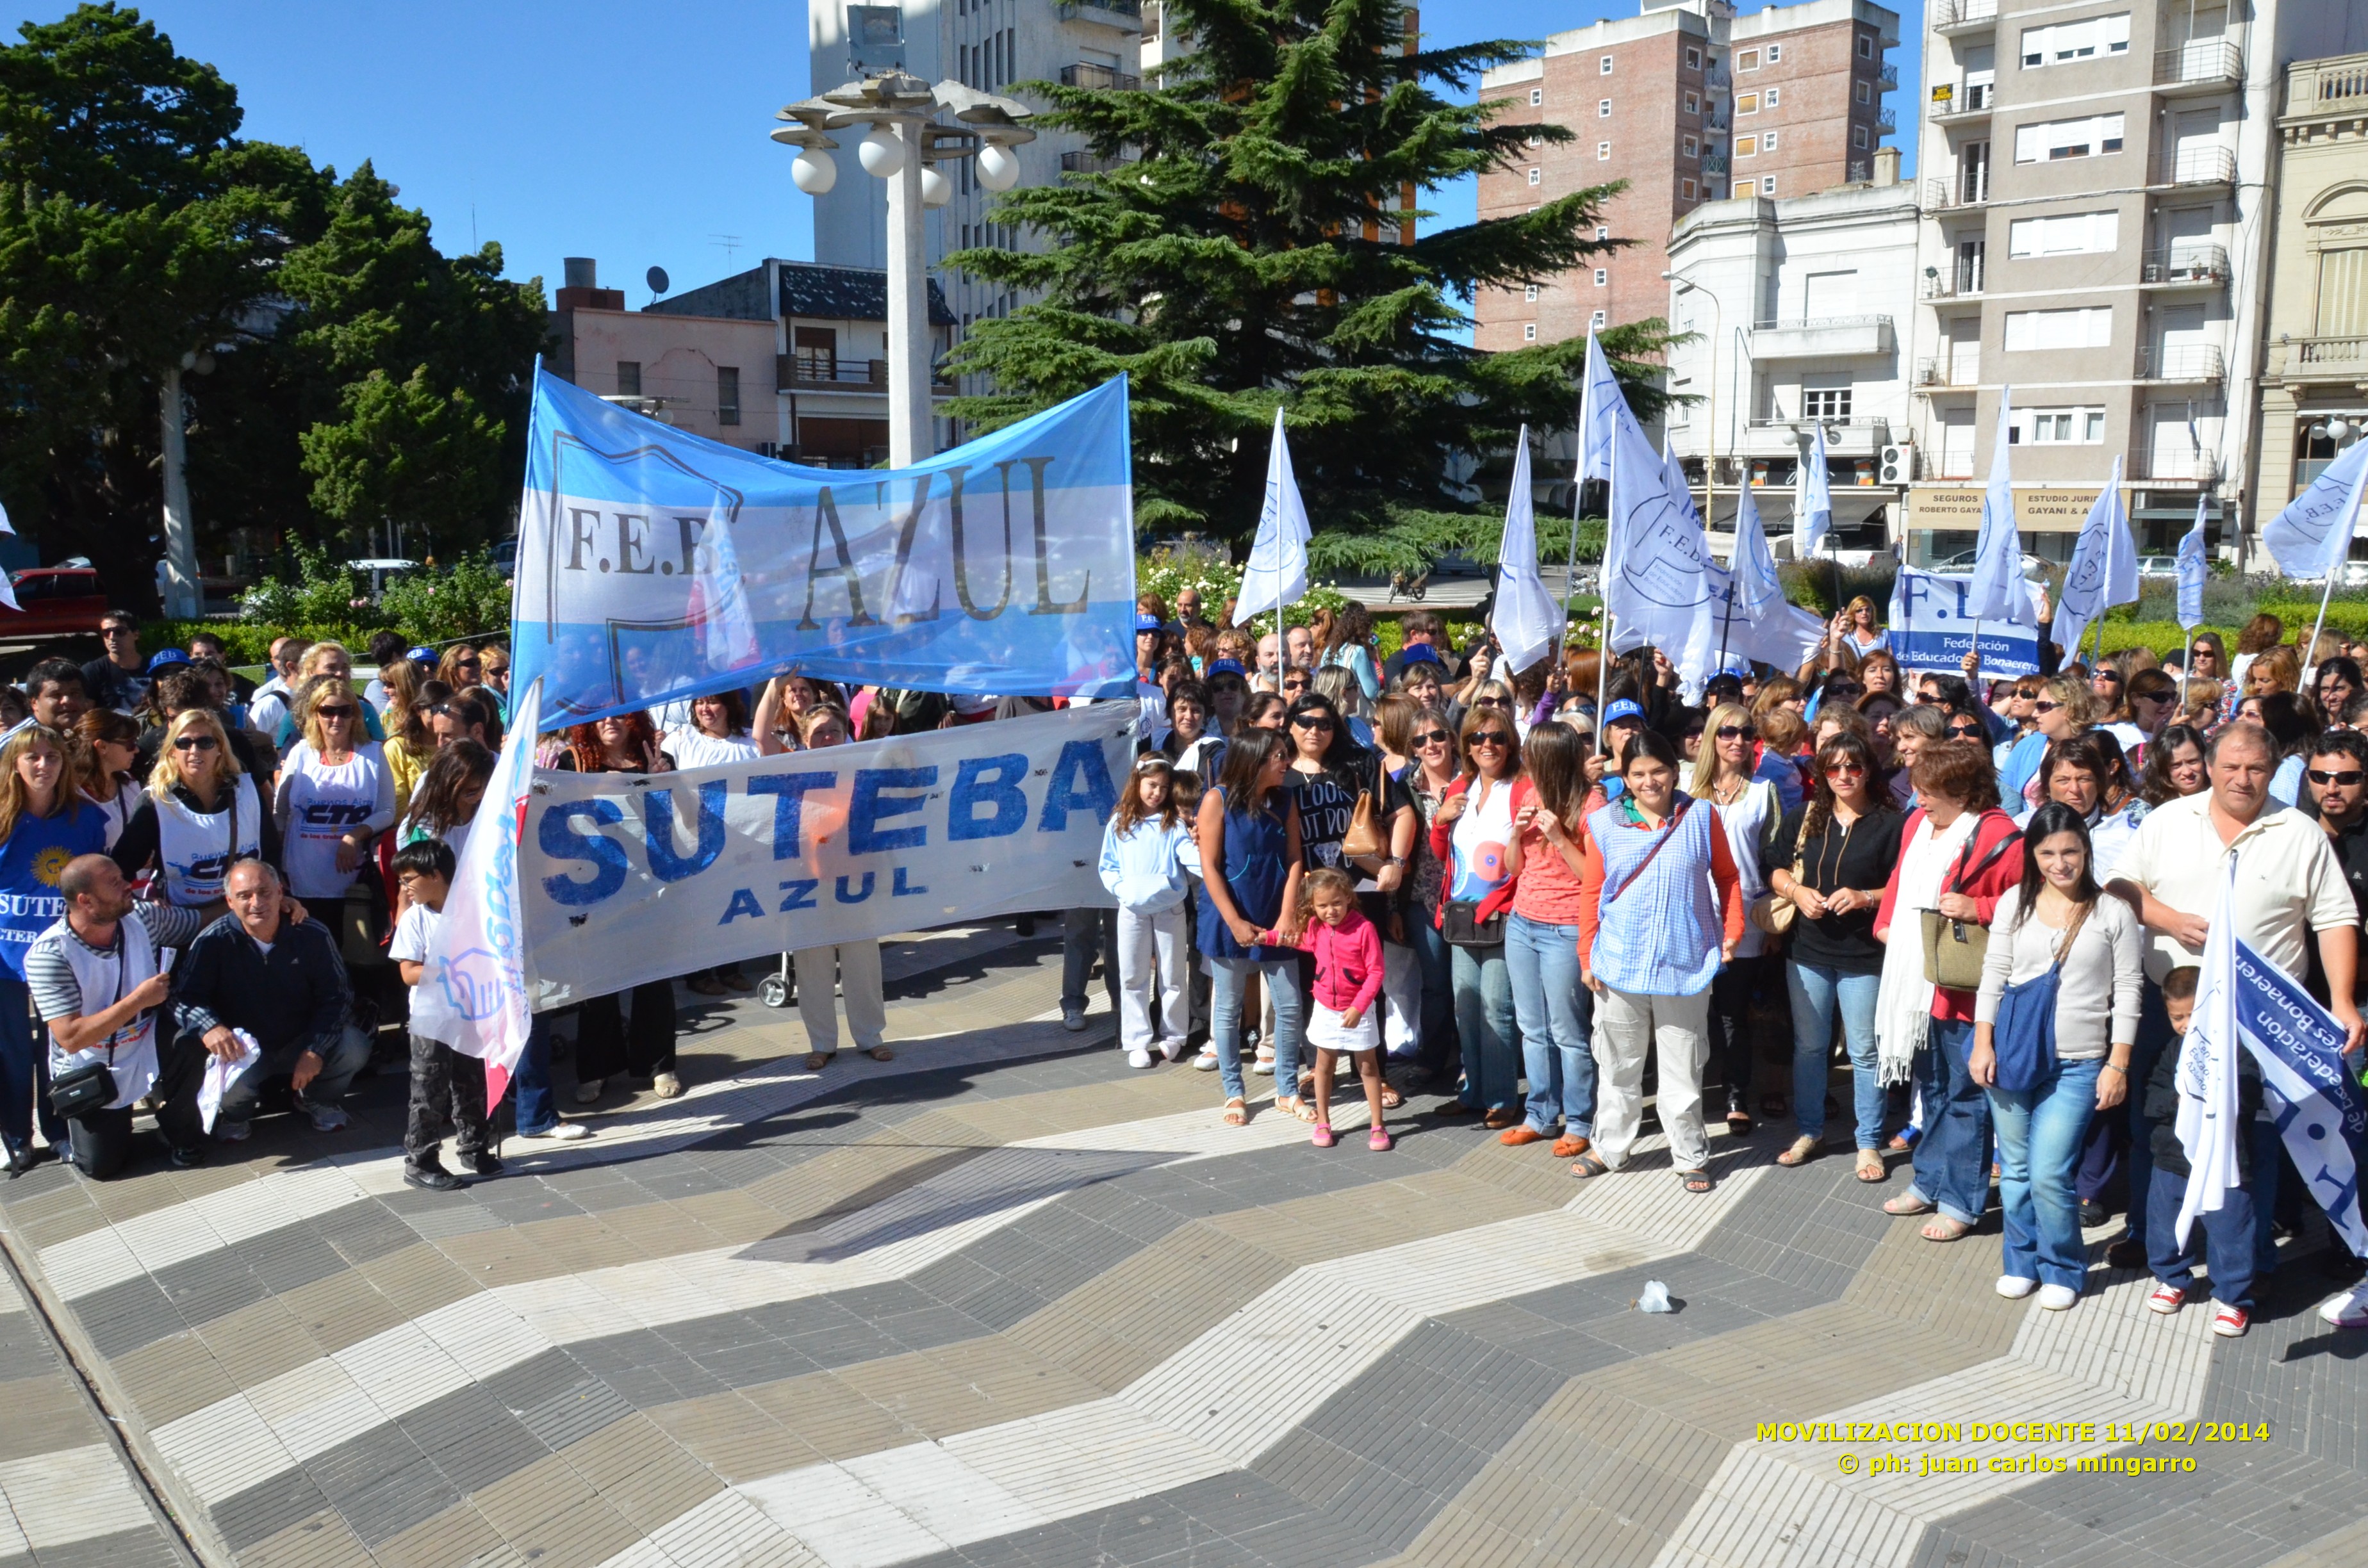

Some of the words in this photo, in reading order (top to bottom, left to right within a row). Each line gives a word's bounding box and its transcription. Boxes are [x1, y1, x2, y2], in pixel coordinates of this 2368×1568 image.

[1933, 494, 1978, 503] SEGUROS
[2027, 507, 2067, 515] GAYANI
[2070, 507, 2078, 515] &
[796, 457, 1089, 630] AZUL
[1896, 652, 1909, 661] de
[1612, 699, 1638, 711] FEB
[538, 739, 1118, 906] SUTEBA
[1299, 812, 1321, 840] UT
[192, 849, 229, 862] Bueno
[718, 867, 929, 926] AZUL
[2235, 952, 2314, 1033] Bonaeren
[2256, 1010, 2343, 1086] ederación
